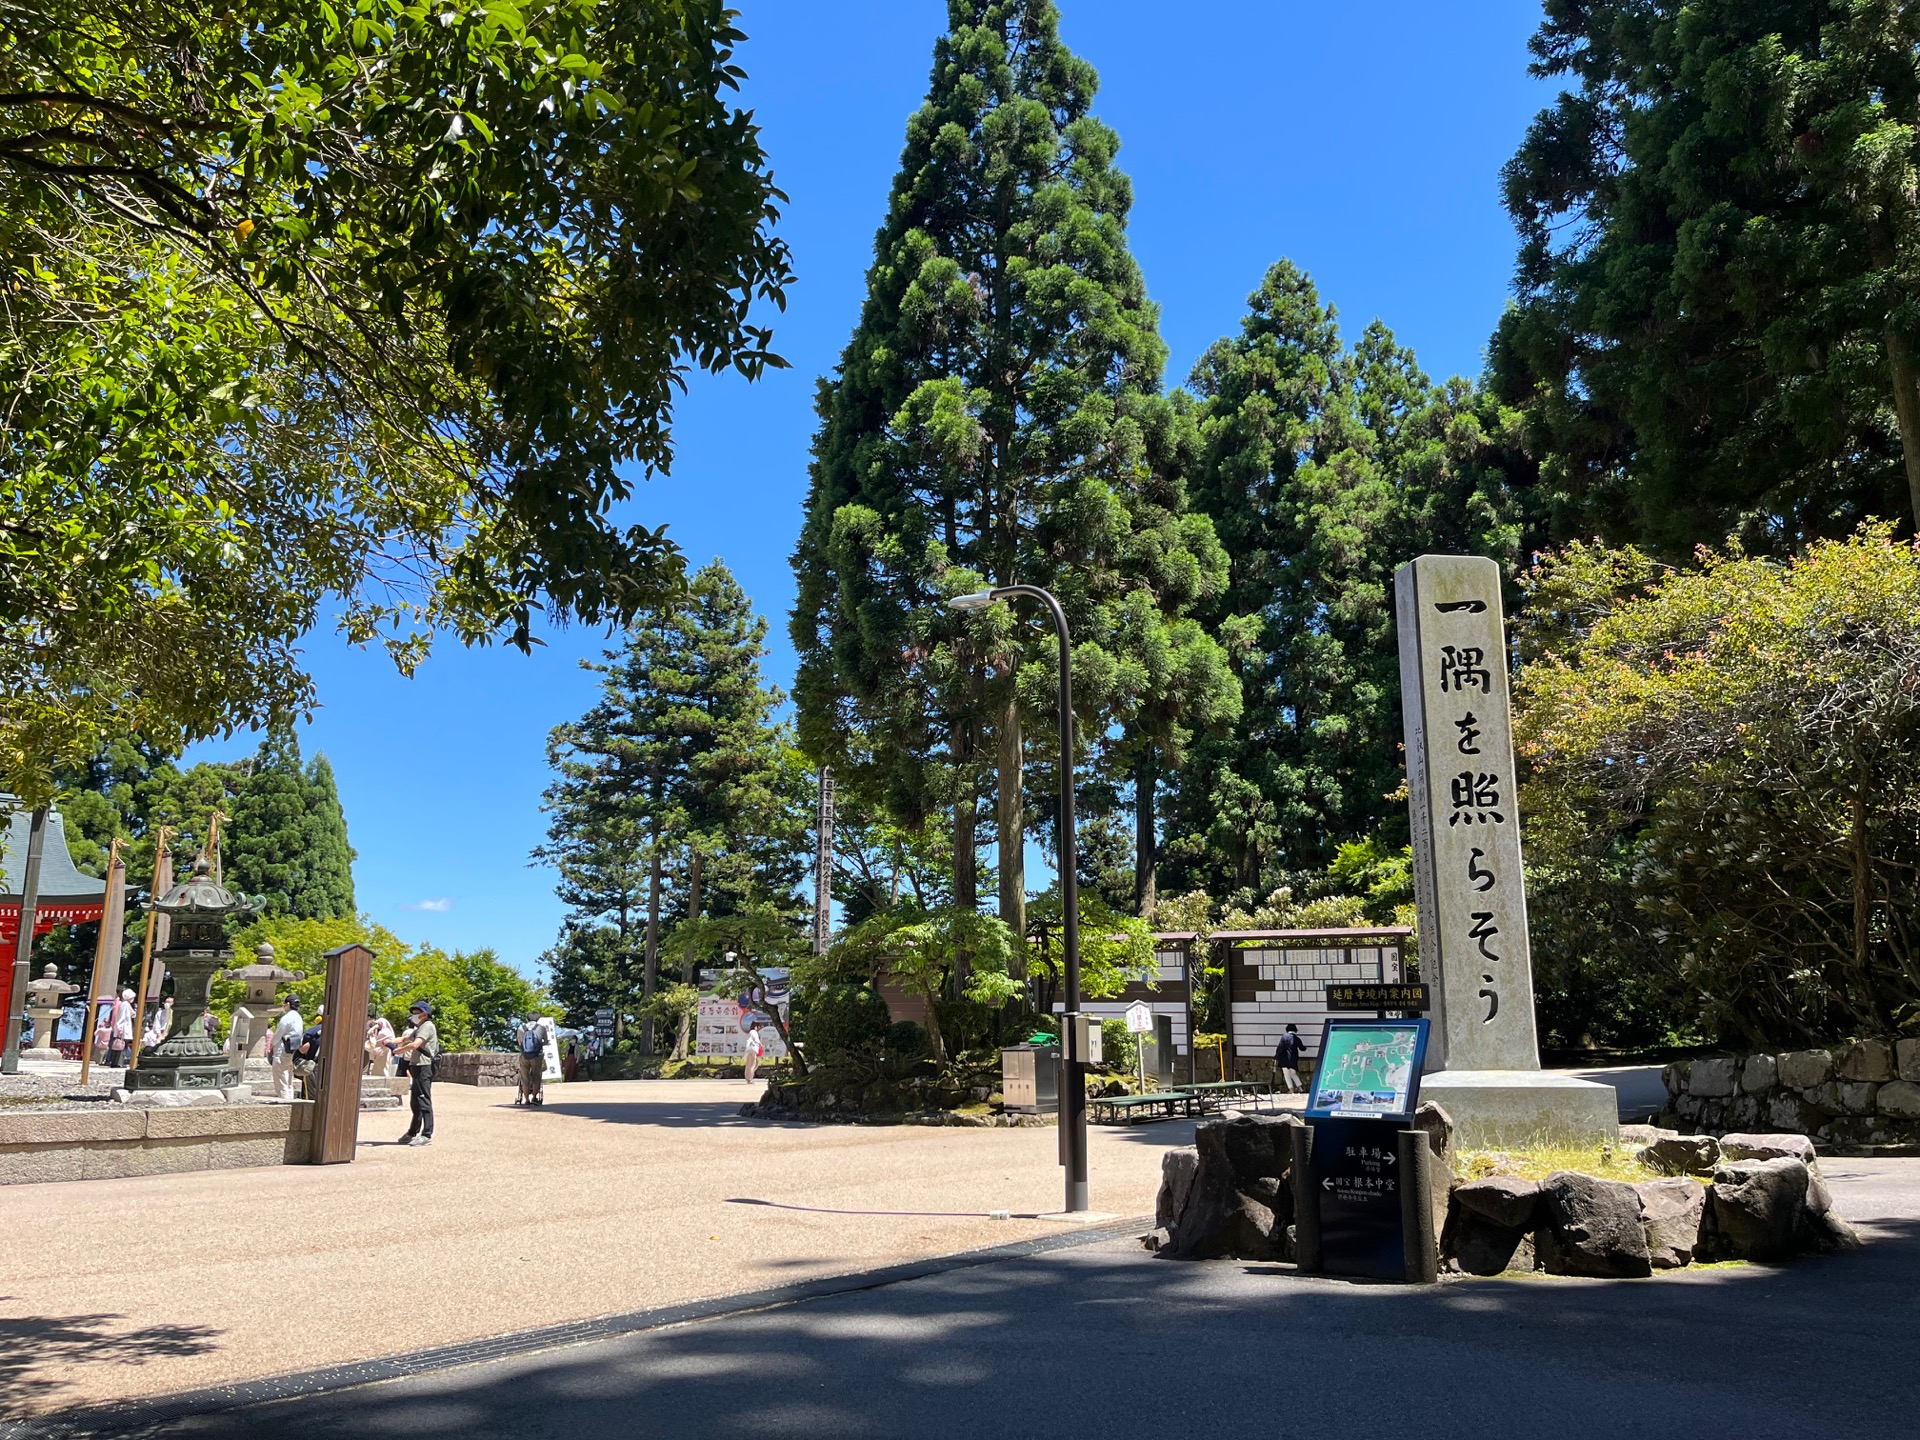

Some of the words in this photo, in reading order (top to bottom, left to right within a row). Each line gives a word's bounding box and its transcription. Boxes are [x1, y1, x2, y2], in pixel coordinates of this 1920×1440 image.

[1434, 599, 1505, 1025] 一隅を照らそう
[1332, 987, 1423, 1000] 延暦寺境内案内図
[1345, 1146, 1381, 1159] 駐車場
[1354, 1176, 1396, 1191] 根本中堂
